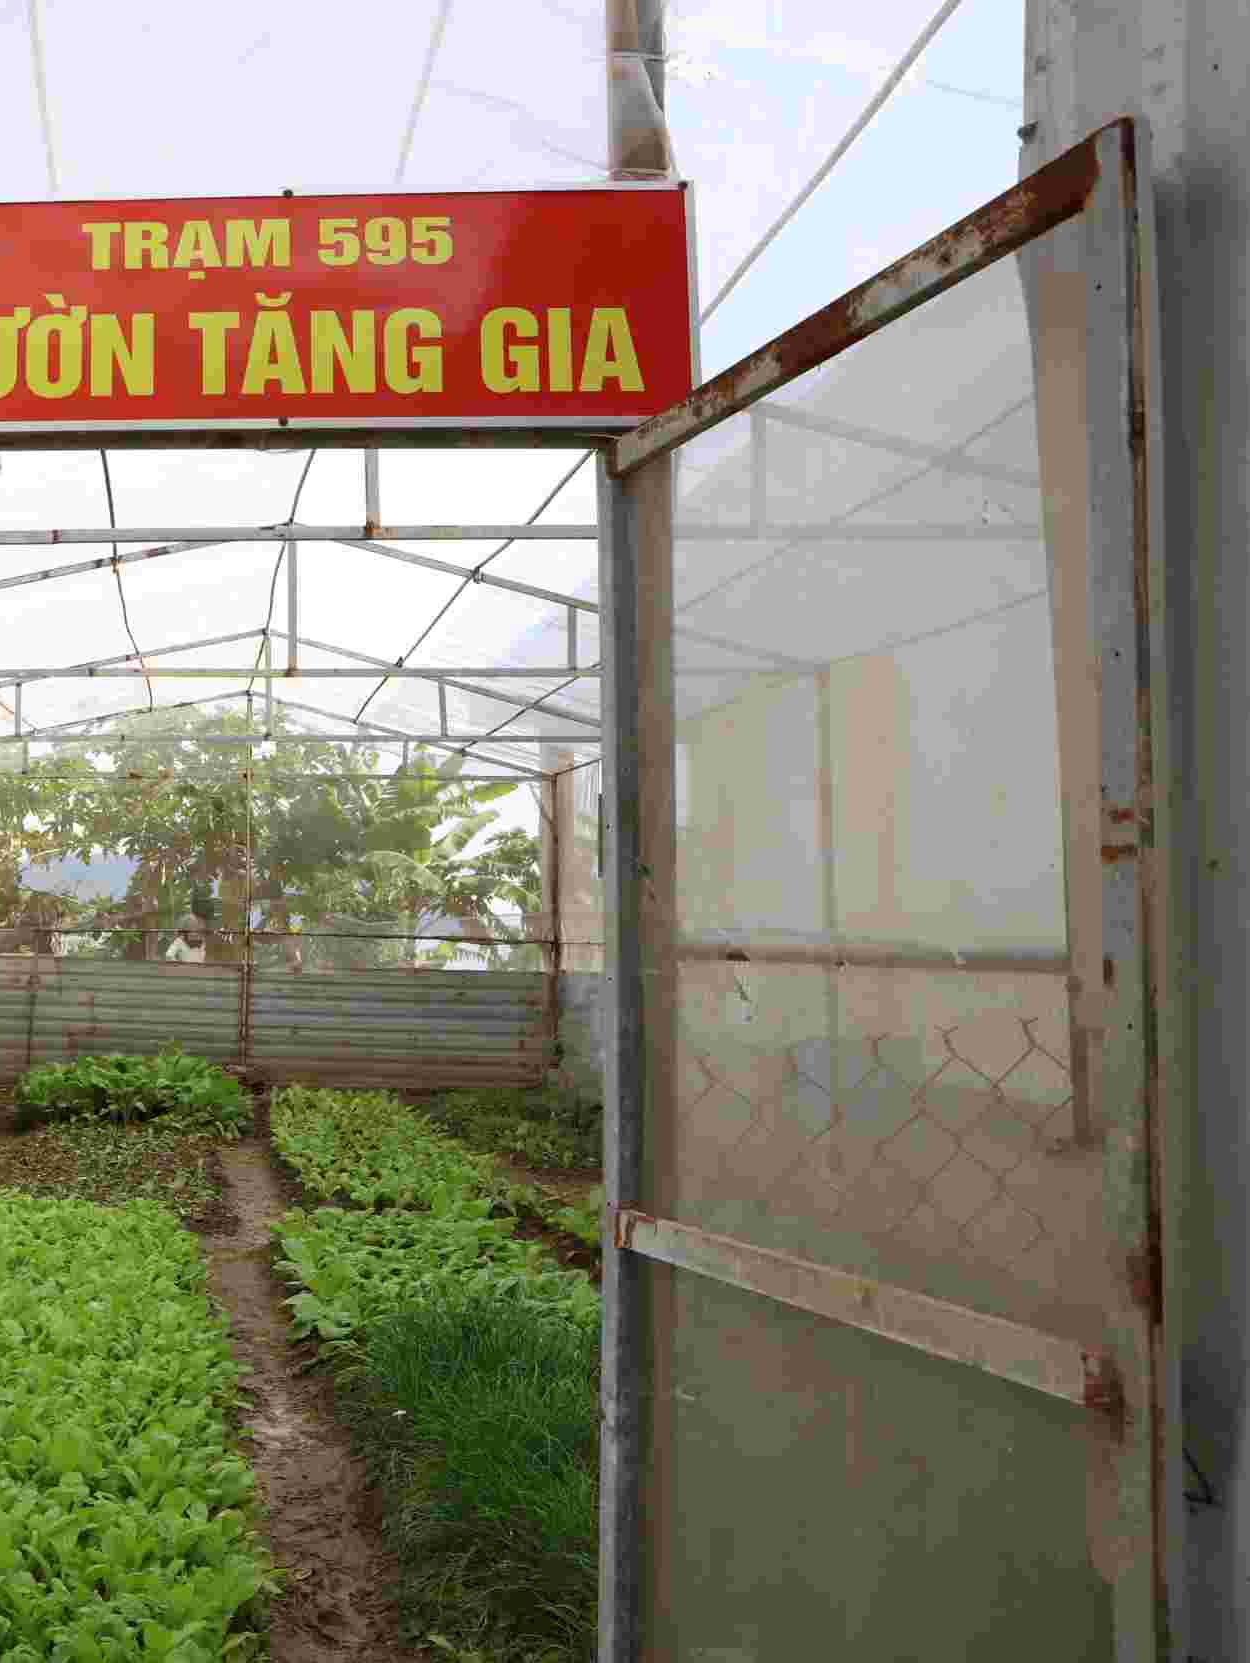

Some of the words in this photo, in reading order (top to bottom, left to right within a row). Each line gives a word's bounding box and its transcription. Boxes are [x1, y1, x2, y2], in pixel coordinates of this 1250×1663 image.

[83, 217, 291, 280] TRẠM
[318, 216, 454, 266] 595
[189, 291, 444, 395] TĂNG
[480, 305, 645, 393] GIA
